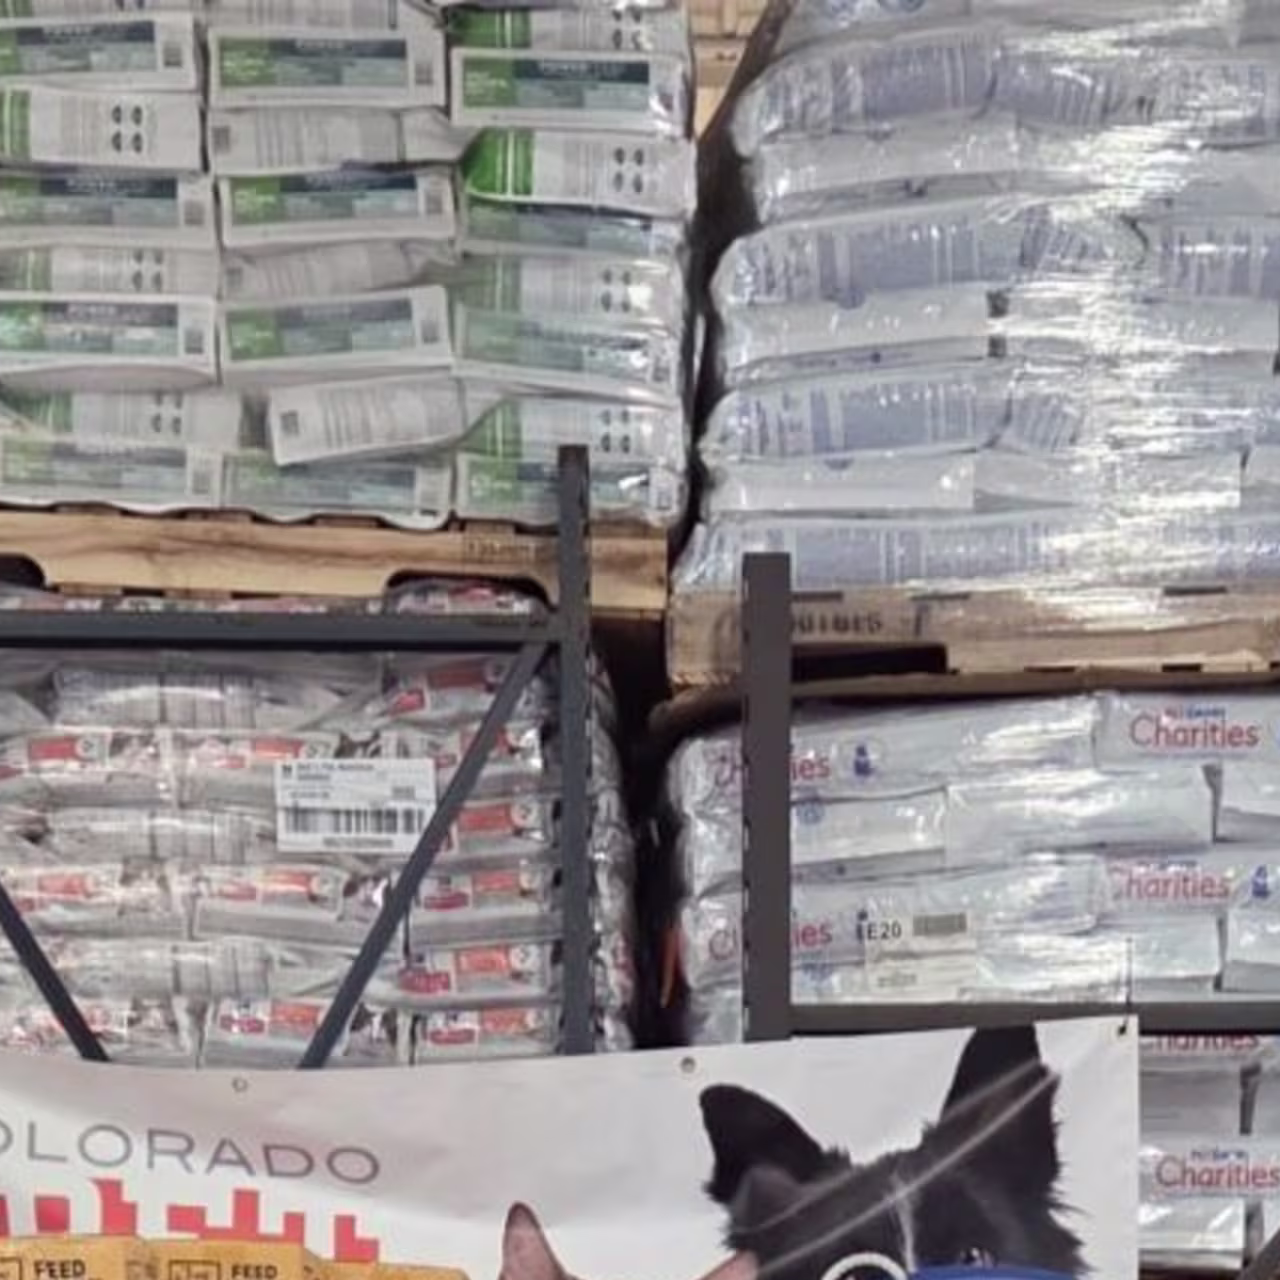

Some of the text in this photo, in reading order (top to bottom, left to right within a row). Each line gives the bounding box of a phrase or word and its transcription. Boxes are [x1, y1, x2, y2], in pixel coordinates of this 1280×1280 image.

[1130, 710, 1261, 748] Charities
[866, 921, 903, 941] E20
[33, 1259, 86, 1279] FEED
[231, 1264, 278, 1280] FEED
